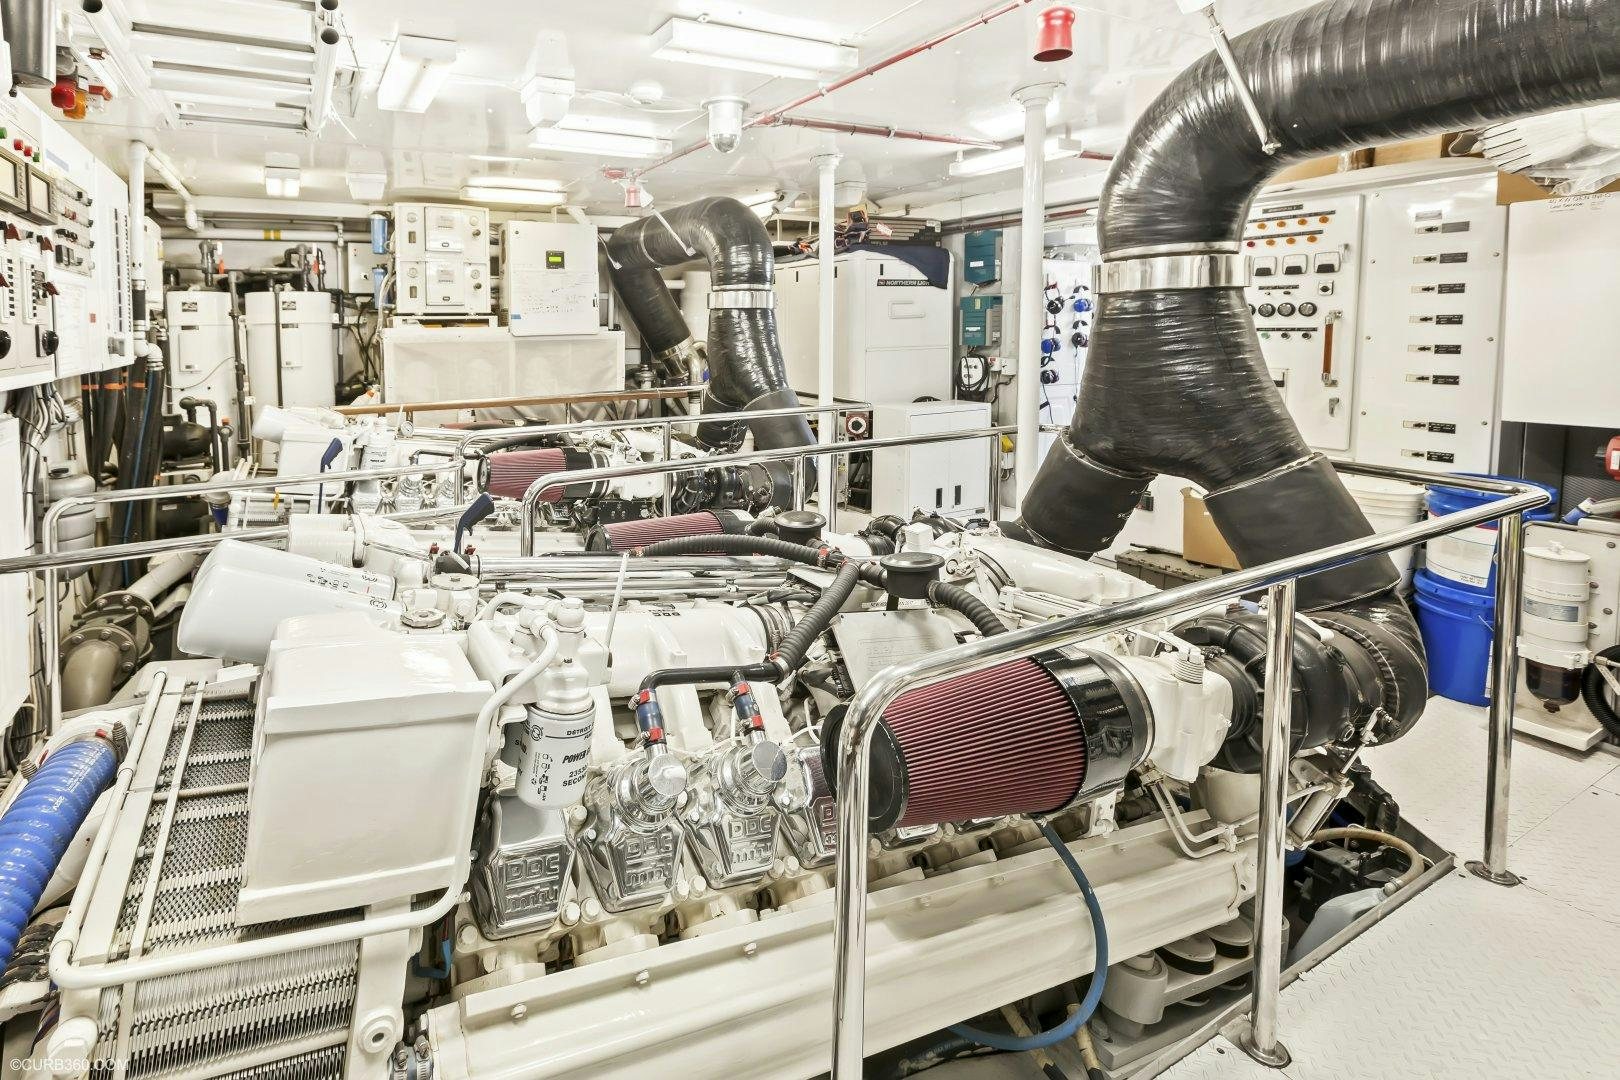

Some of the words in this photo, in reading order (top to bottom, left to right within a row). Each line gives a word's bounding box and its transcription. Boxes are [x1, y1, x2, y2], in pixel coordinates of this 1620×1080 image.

[562, 749, 586, 764] POWER
[562, 771, 587, 787] SECON
[505, 853, 560, 883] DDC
